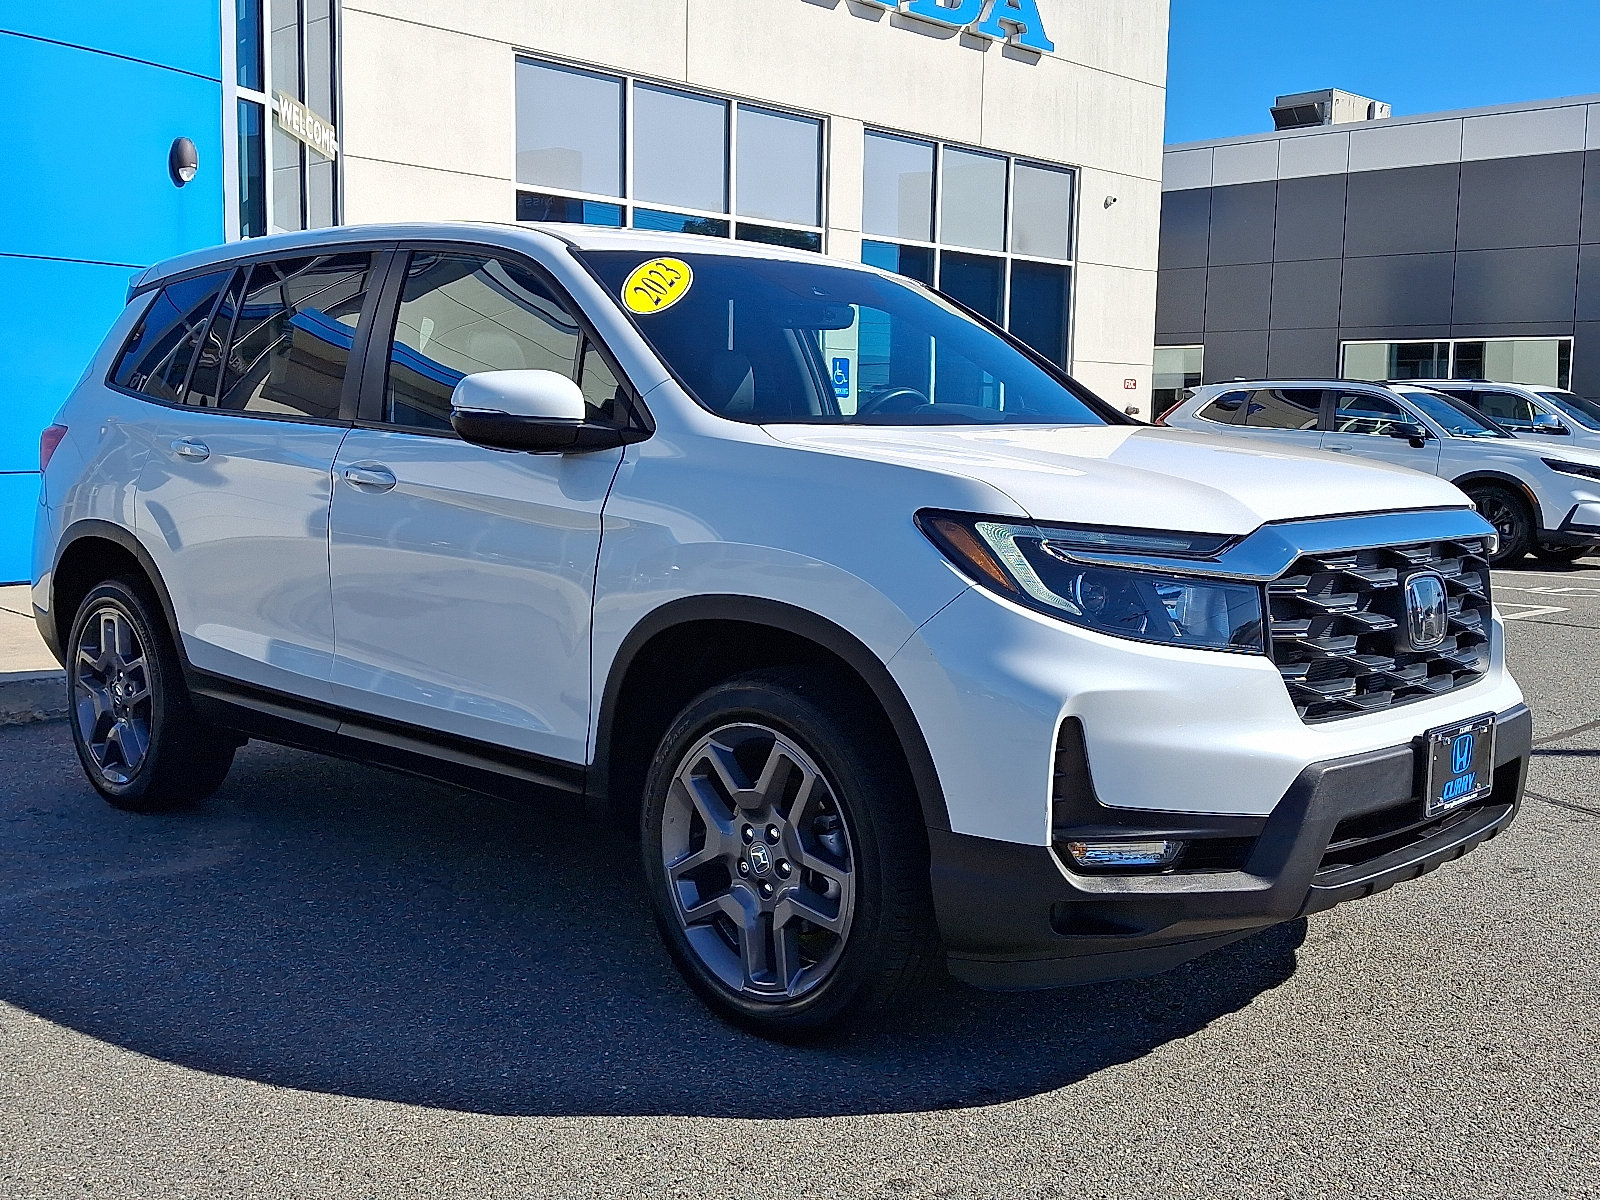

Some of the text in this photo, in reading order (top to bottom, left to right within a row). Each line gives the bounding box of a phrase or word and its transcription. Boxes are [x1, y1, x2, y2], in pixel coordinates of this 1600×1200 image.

[279, 94, 336, 155] WELCOME
[633, 262, 682, 306] 2023
[1443, 771, 1476, 801] CURRY
